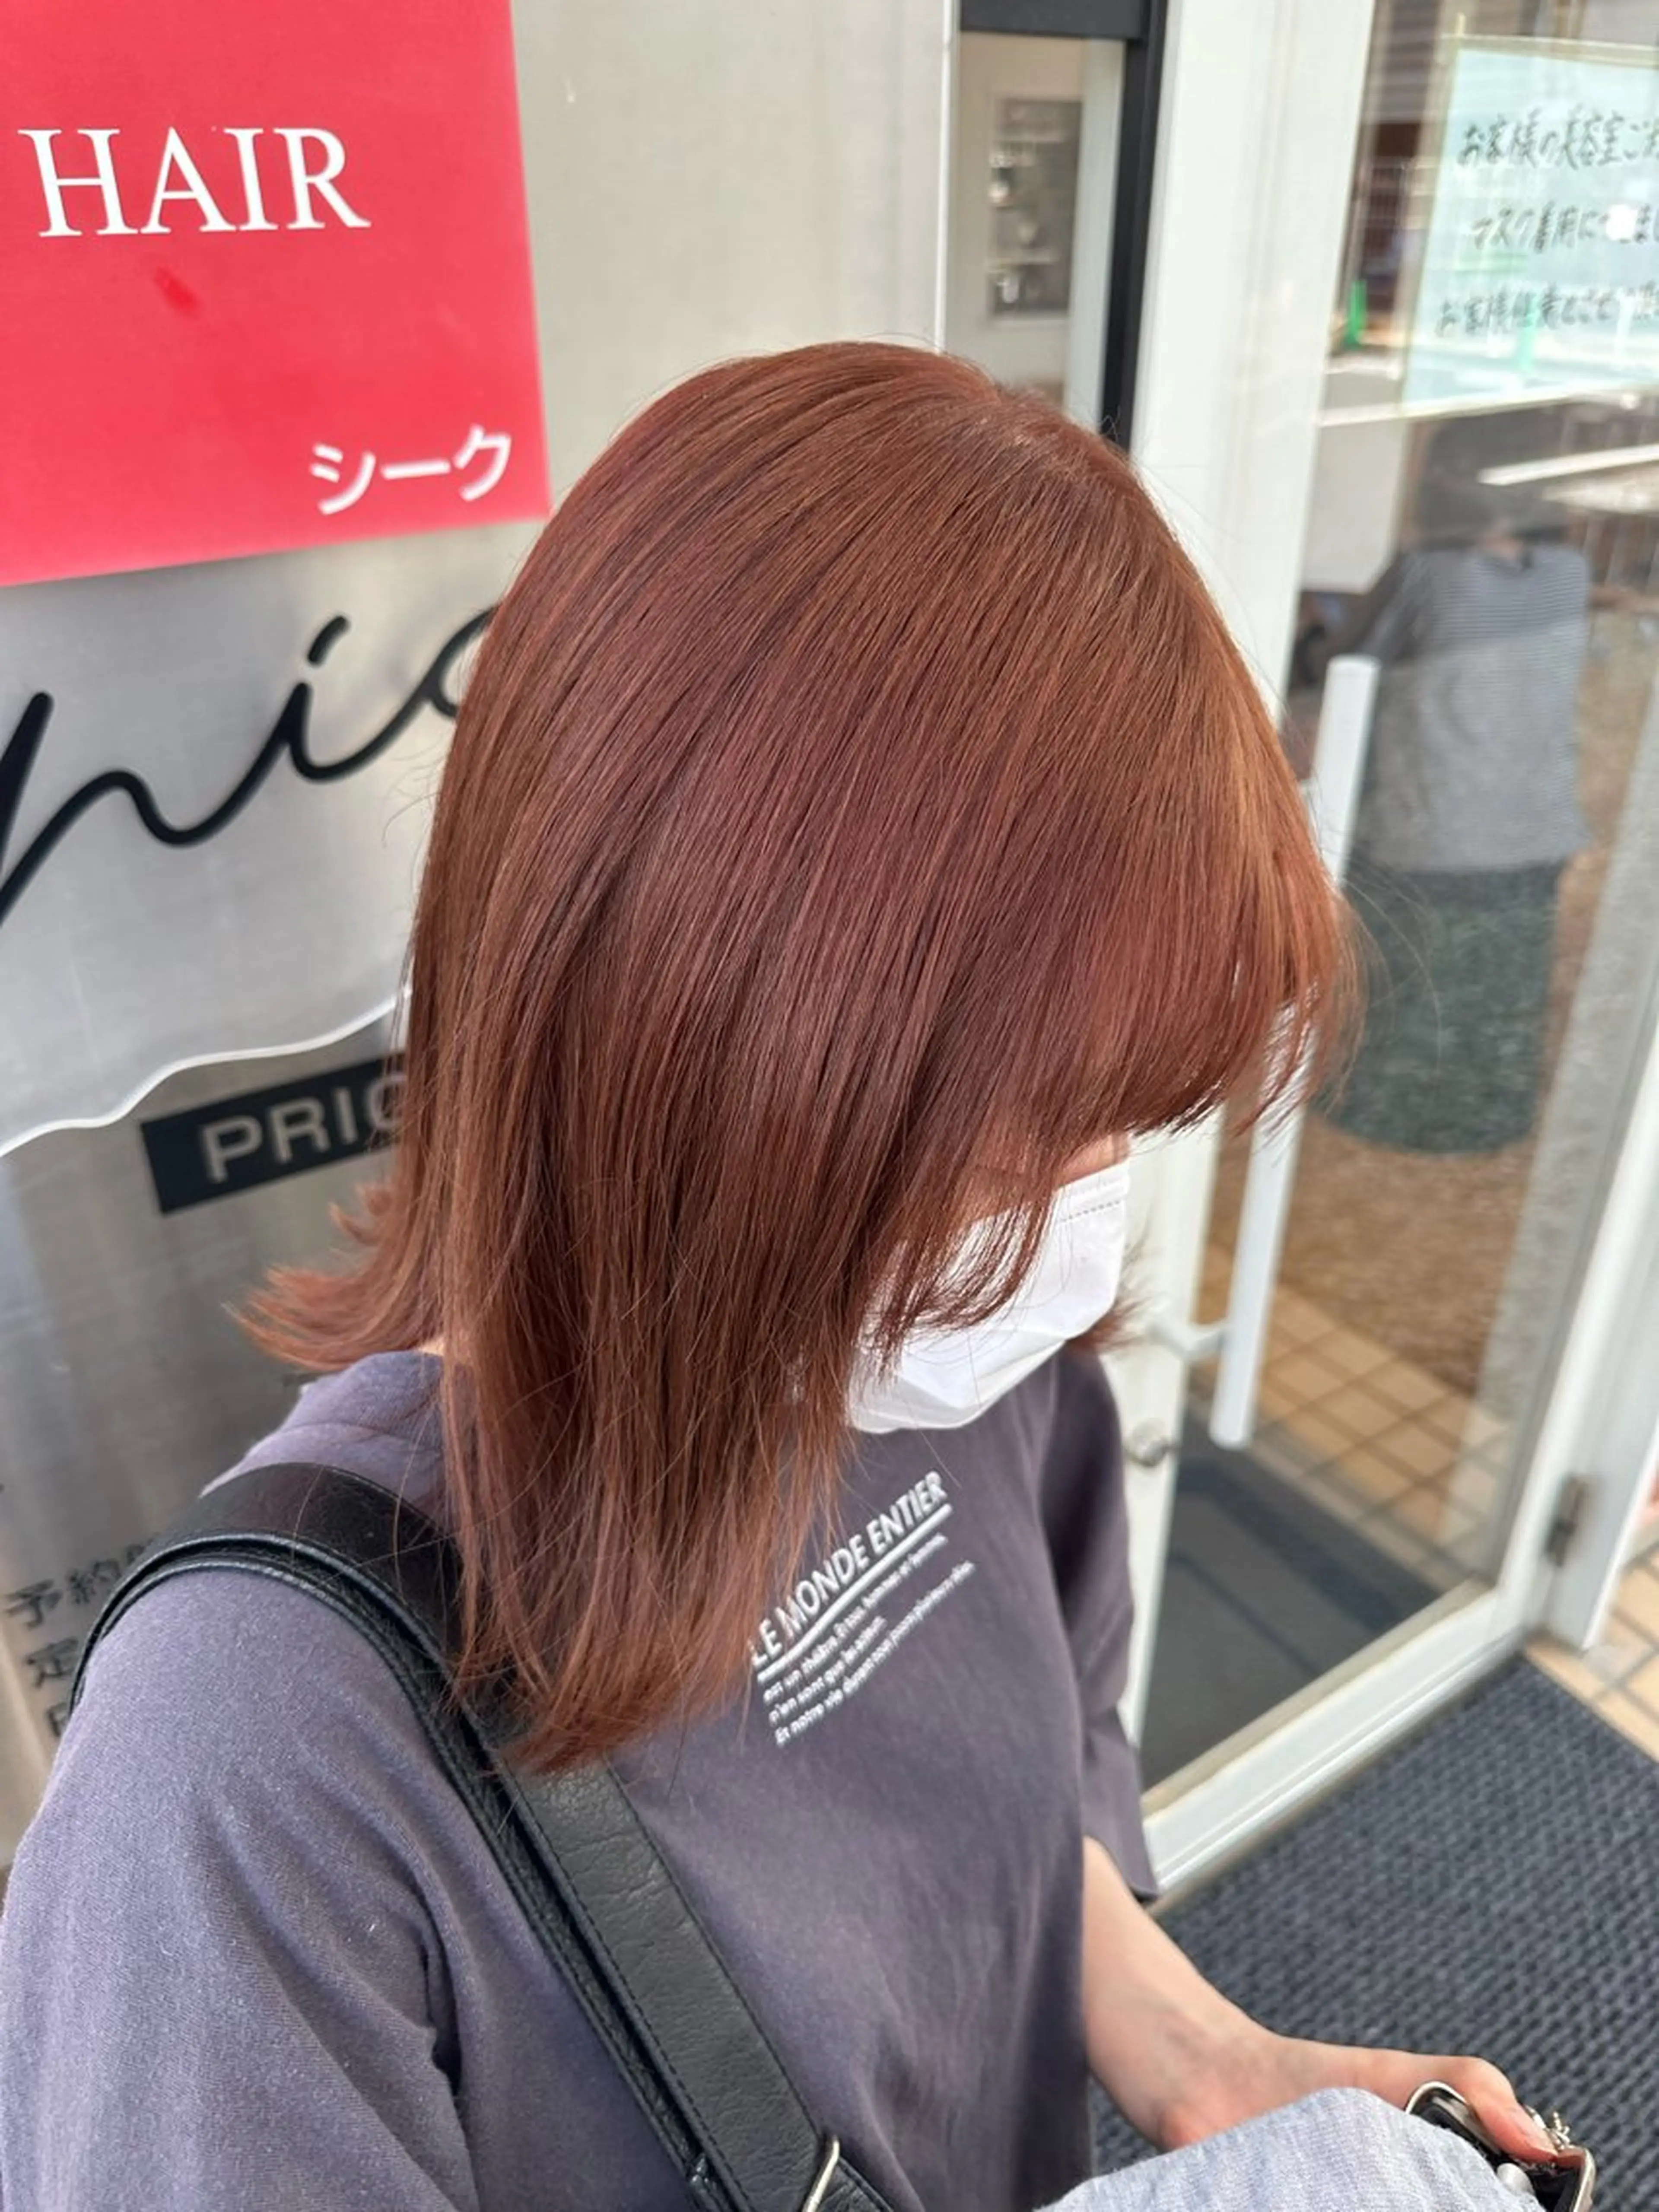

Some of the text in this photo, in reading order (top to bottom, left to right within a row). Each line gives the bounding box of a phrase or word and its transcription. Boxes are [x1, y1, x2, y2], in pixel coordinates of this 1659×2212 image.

[18, 127, 372, 237] HAIR
[309, 423, 513, 516] シーク
[748, 1471, 947, 1671] LE MONDE ENTIER
